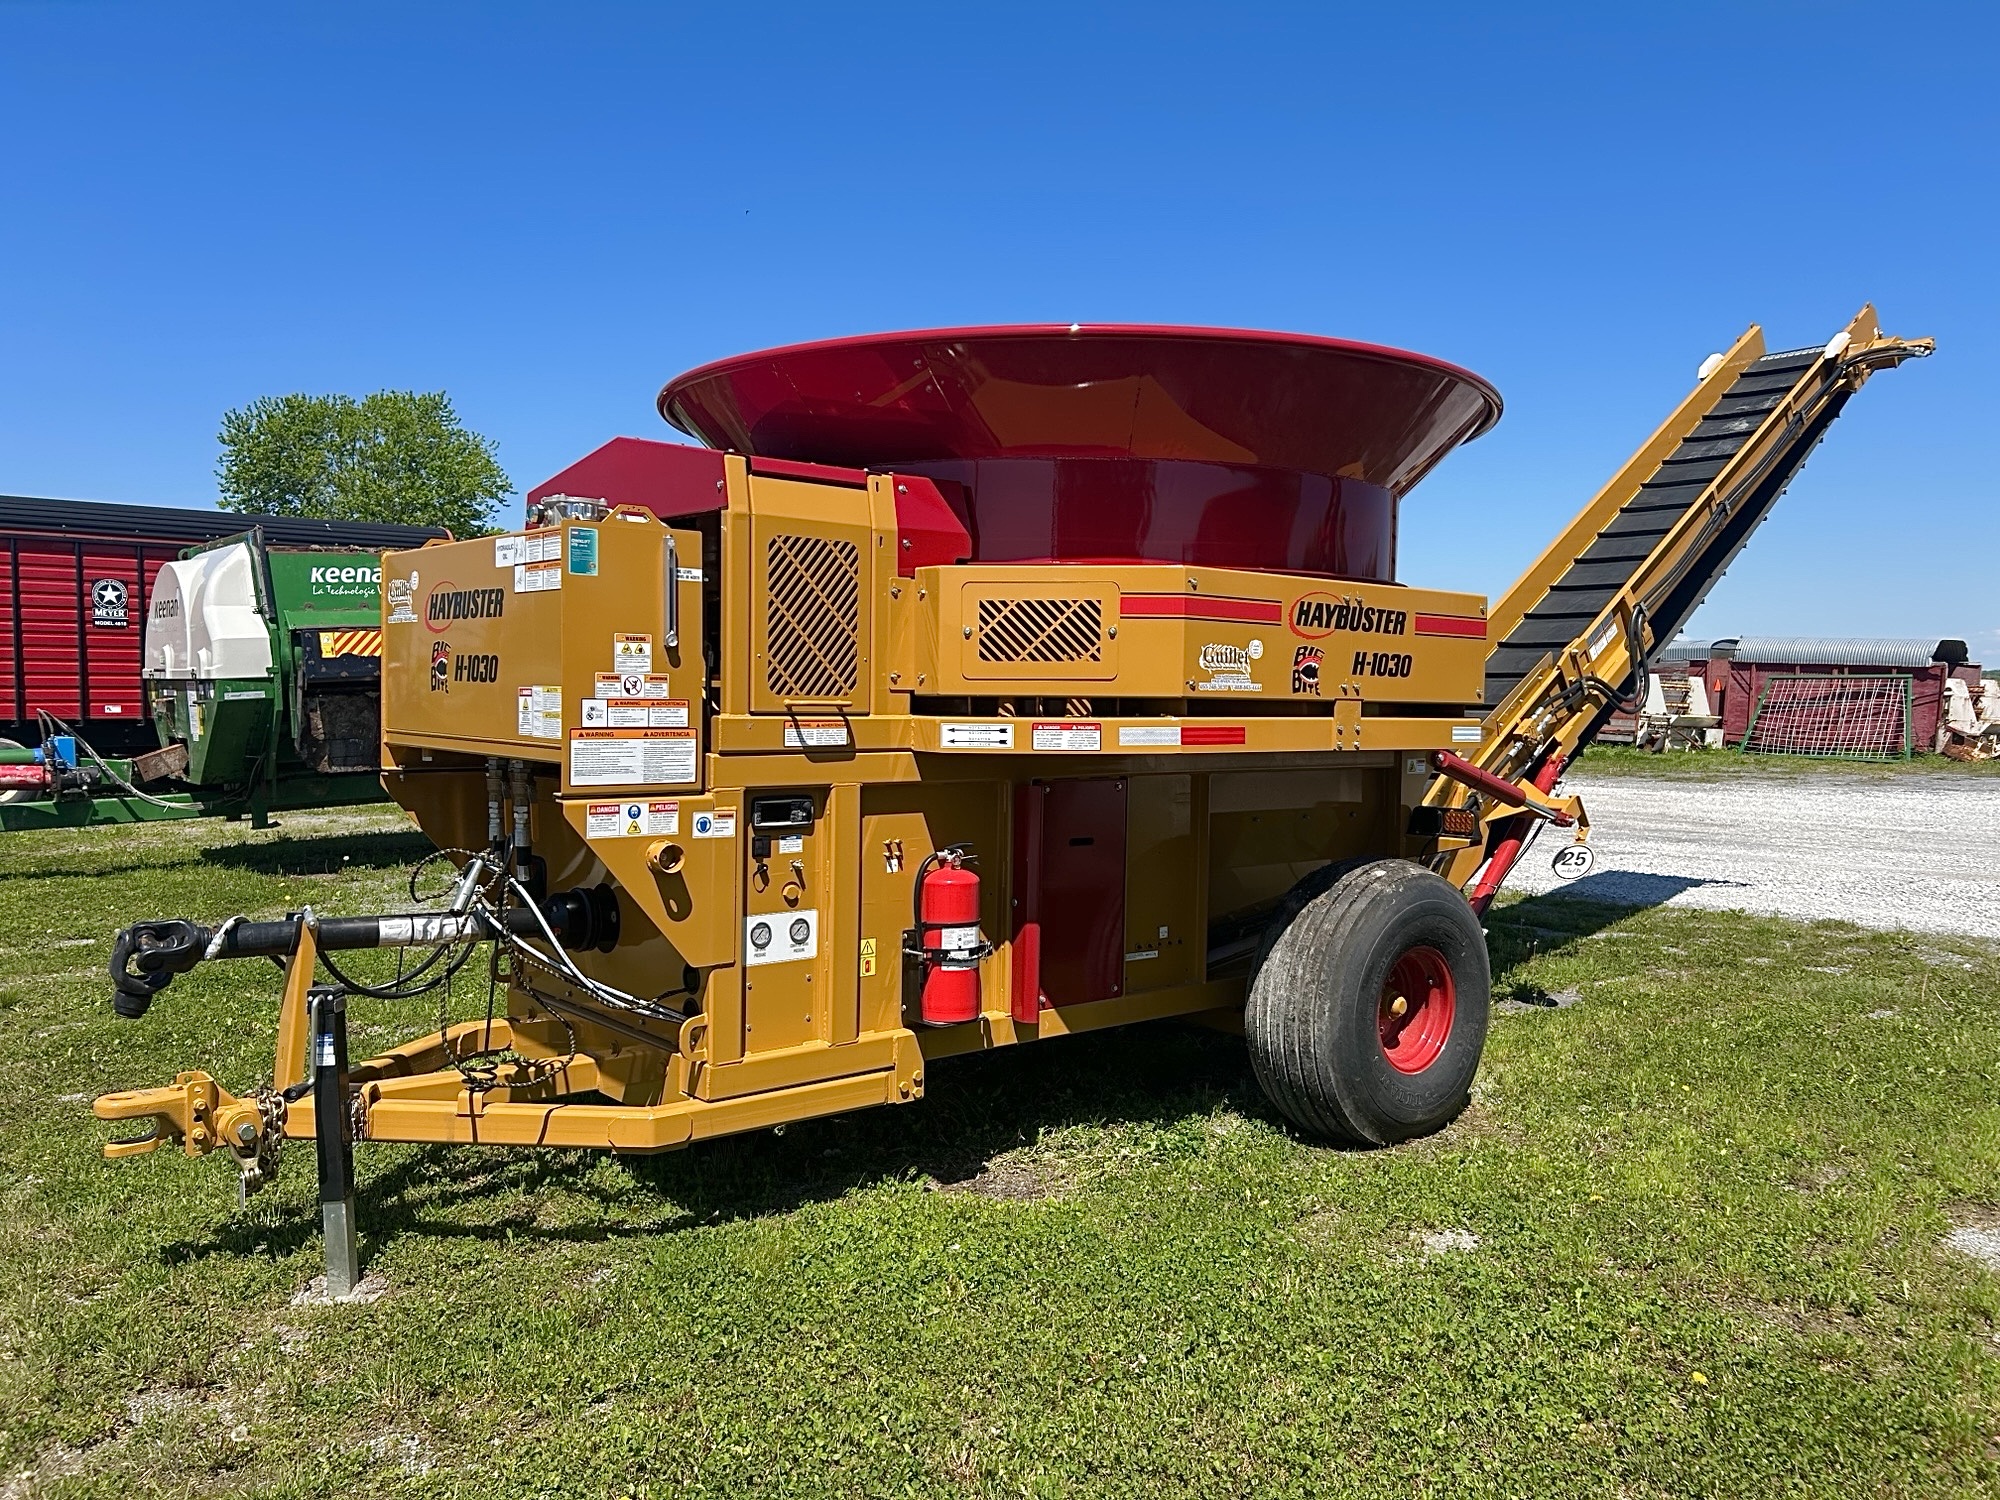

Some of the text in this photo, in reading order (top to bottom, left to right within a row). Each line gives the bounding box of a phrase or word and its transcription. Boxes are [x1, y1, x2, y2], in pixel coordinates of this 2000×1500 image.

[312, 585, 324, 595] La
[326, 584, 376, 598] Technologie
[95, 609, 124, 617] MEYER
[154, 599, 179, 618] Keenan
[428, 588, 505, 620] HAYBUSTER
[1295, 600, 1407, 636] HAYBUSTER
[1202, 646, 1249, 665] Guillet
[1293, 645, 1326, 667] BIG
[1352, 651, 1413, 678] H-1030
[454, 654, 499, 683] H-1030
[1292, 669, 1321, 697] BITE
[655, 803, 677, 812] PELIGRO
[1561, 852, 1587, 866] 25
